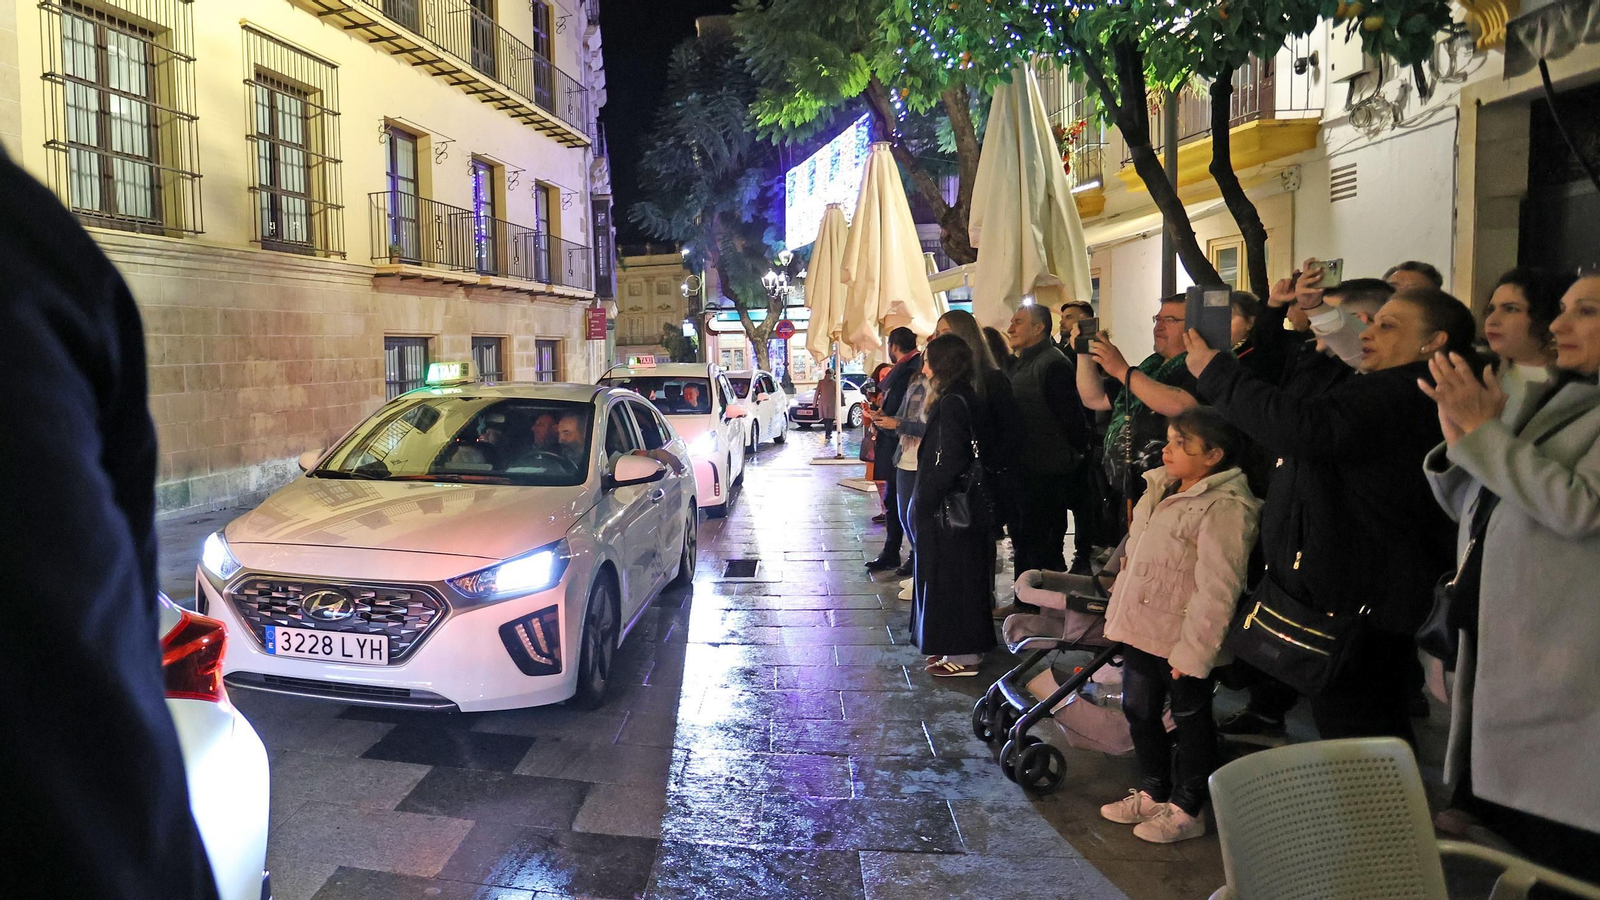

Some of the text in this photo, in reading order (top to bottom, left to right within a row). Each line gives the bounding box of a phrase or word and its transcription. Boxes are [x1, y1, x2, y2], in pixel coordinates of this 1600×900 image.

[639, 356, 654, 364] TAXI
[438, 363, 460, 379] TAXI
[281, 631, 333, 656] 3228
[342, 636, 382, 661] LYH
